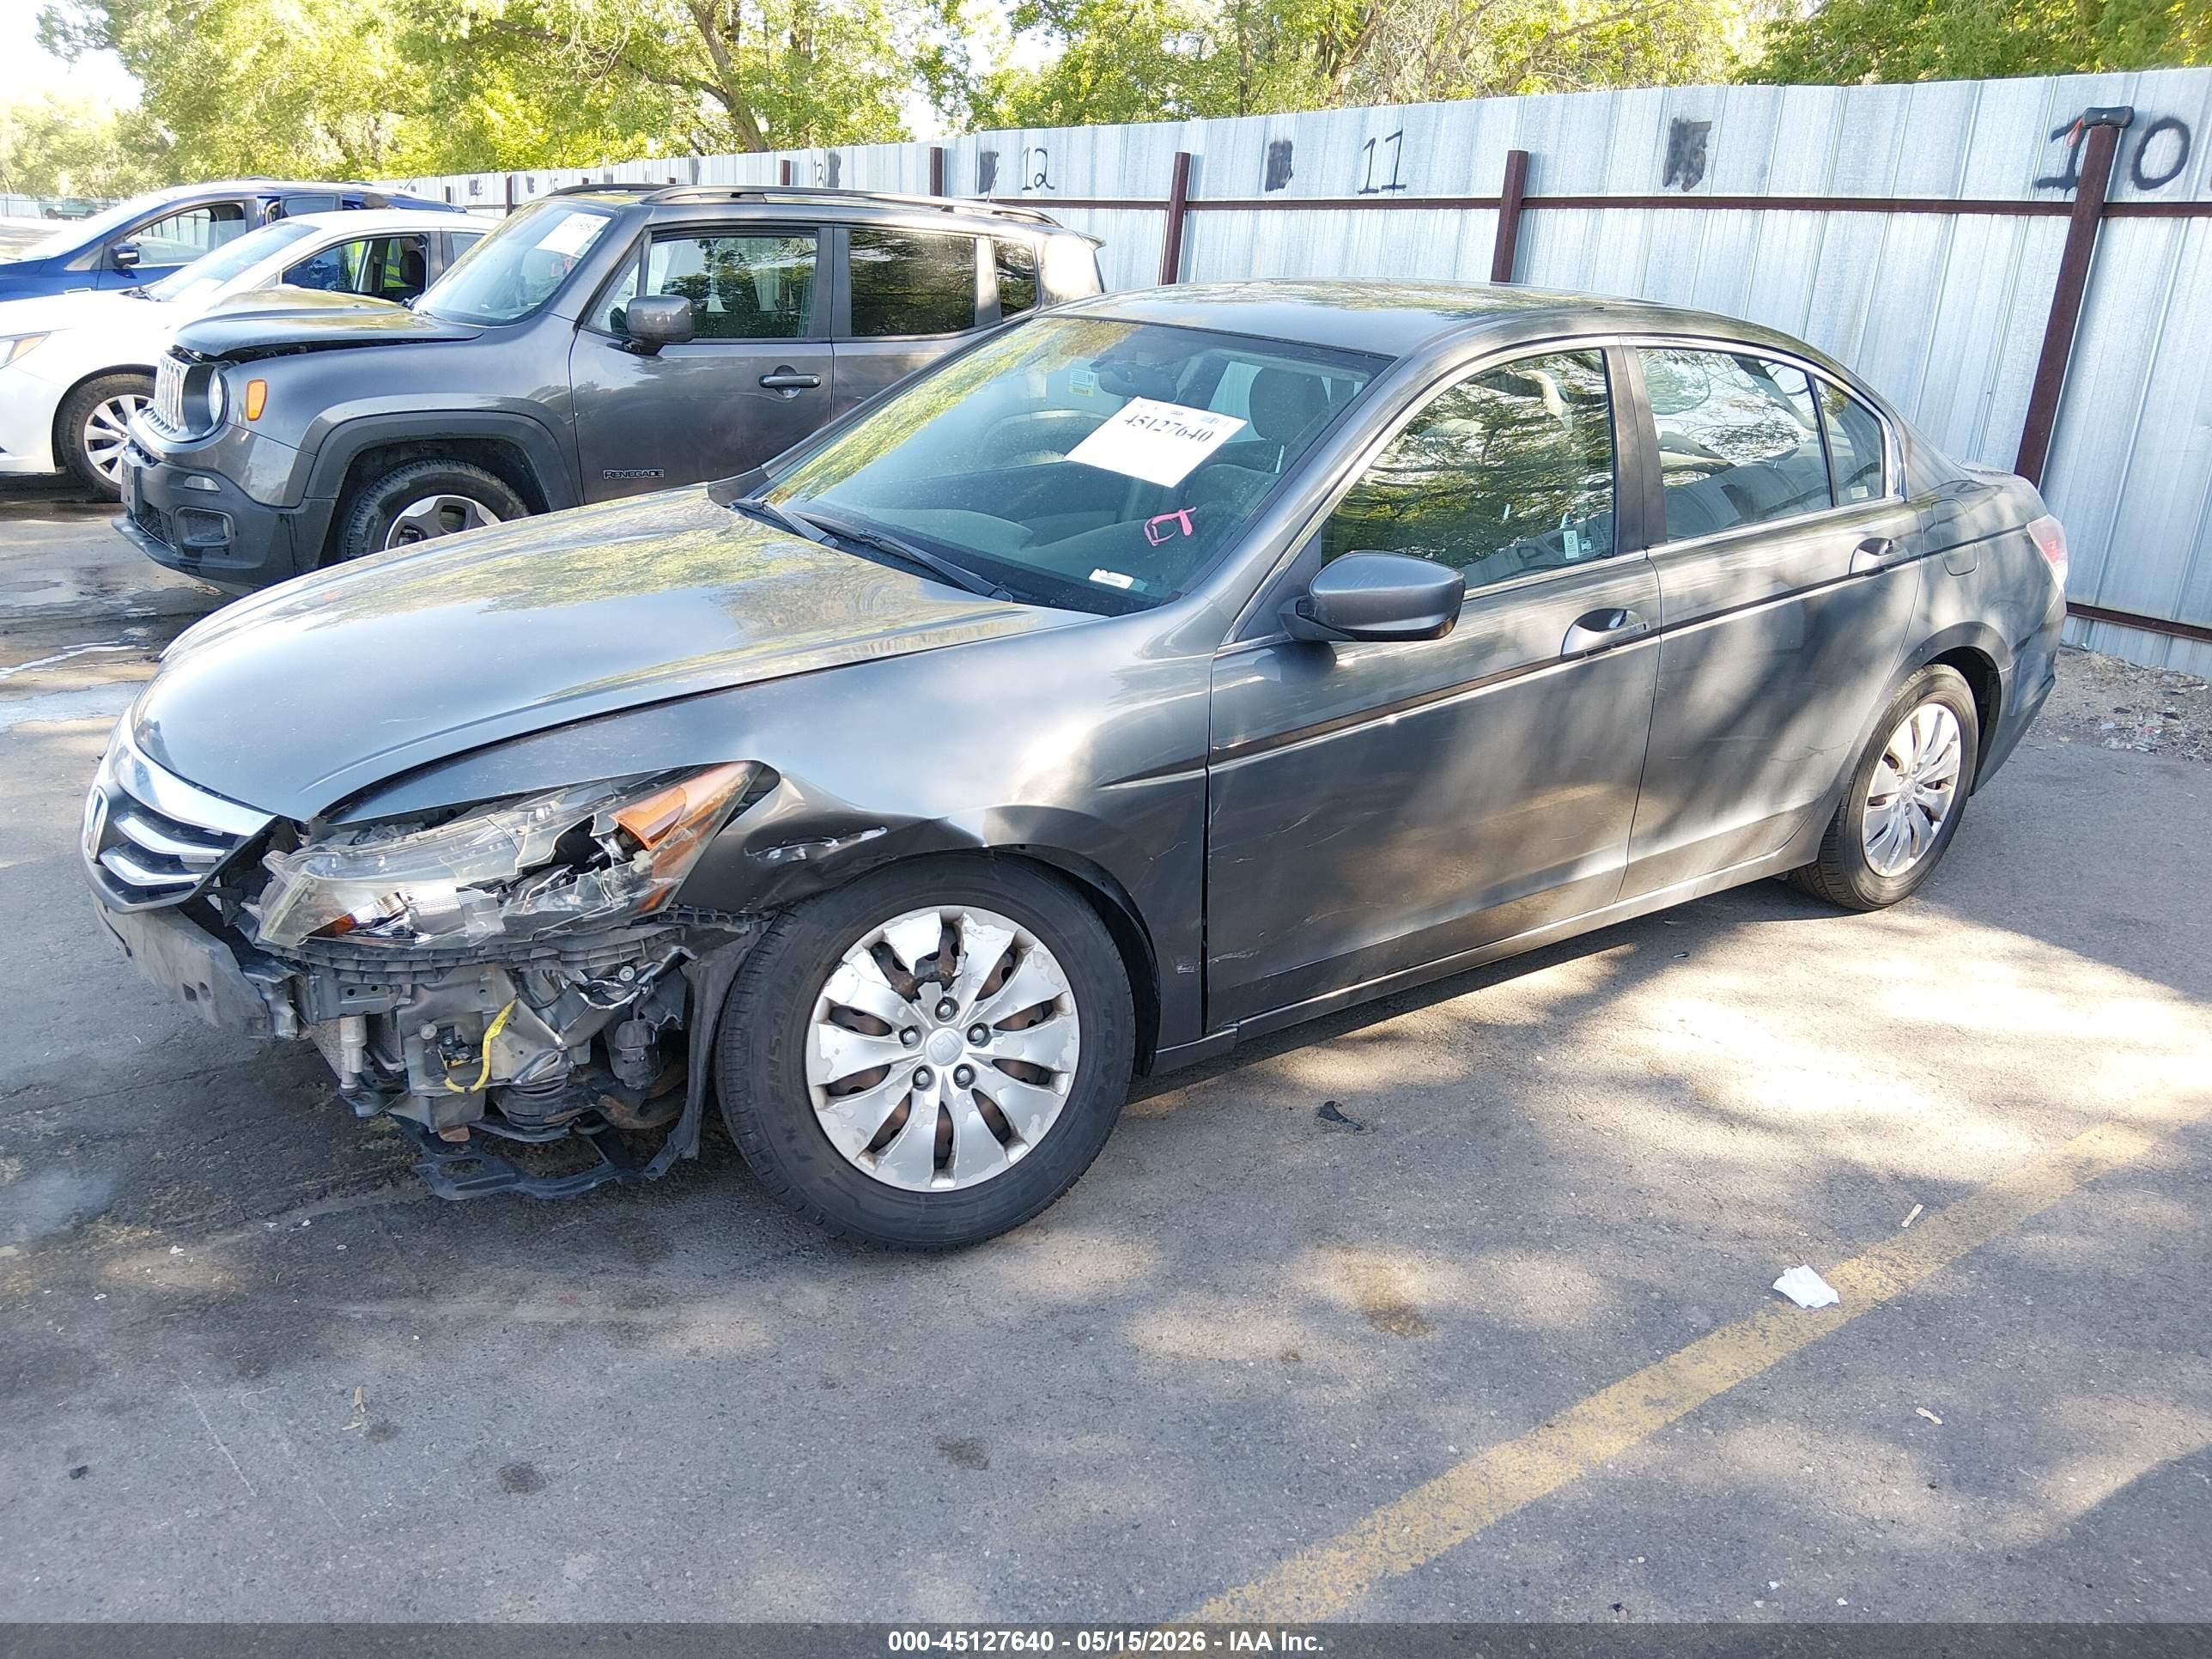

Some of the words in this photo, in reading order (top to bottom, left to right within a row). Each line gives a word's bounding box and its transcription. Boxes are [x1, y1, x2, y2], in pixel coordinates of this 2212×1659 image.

[1022, 147, 1055, 191] 12
[1357, 130, 1407, 194] 11
[2035, 115, 2191, 192] 10
[1124, 413, 1214, 443] 45127640
[603, 469, 665, 479] RENEGADE
